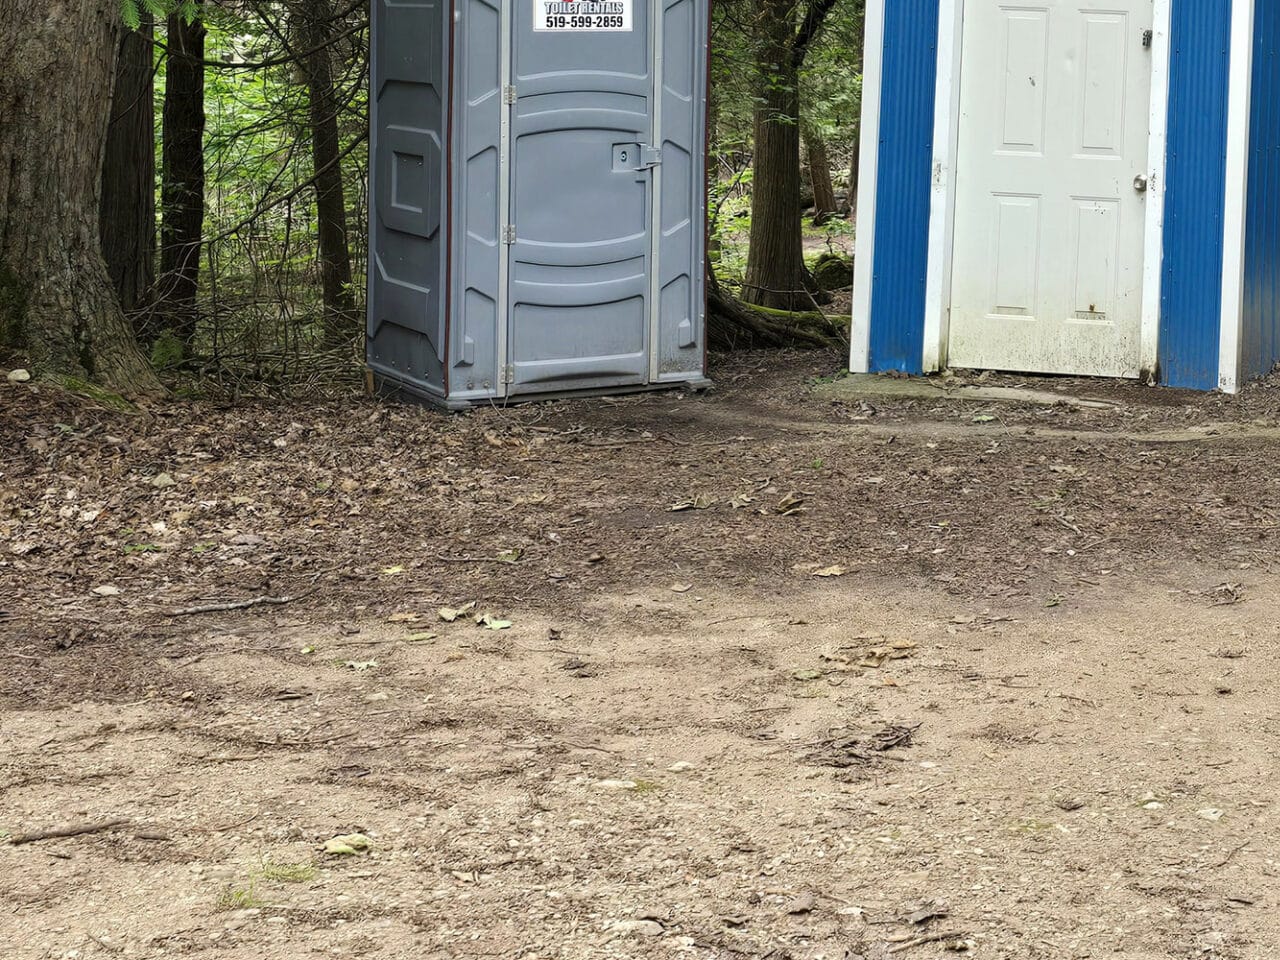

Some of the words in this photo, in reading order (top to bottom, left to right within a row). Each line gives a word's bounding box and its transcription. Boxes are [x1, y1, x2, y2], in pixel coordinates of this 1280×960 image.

[544, 2, 580, 15] TOILET
[581, 2, 624, 15] RENTALS
[546, 16, 623, 28] 519-599-2859
